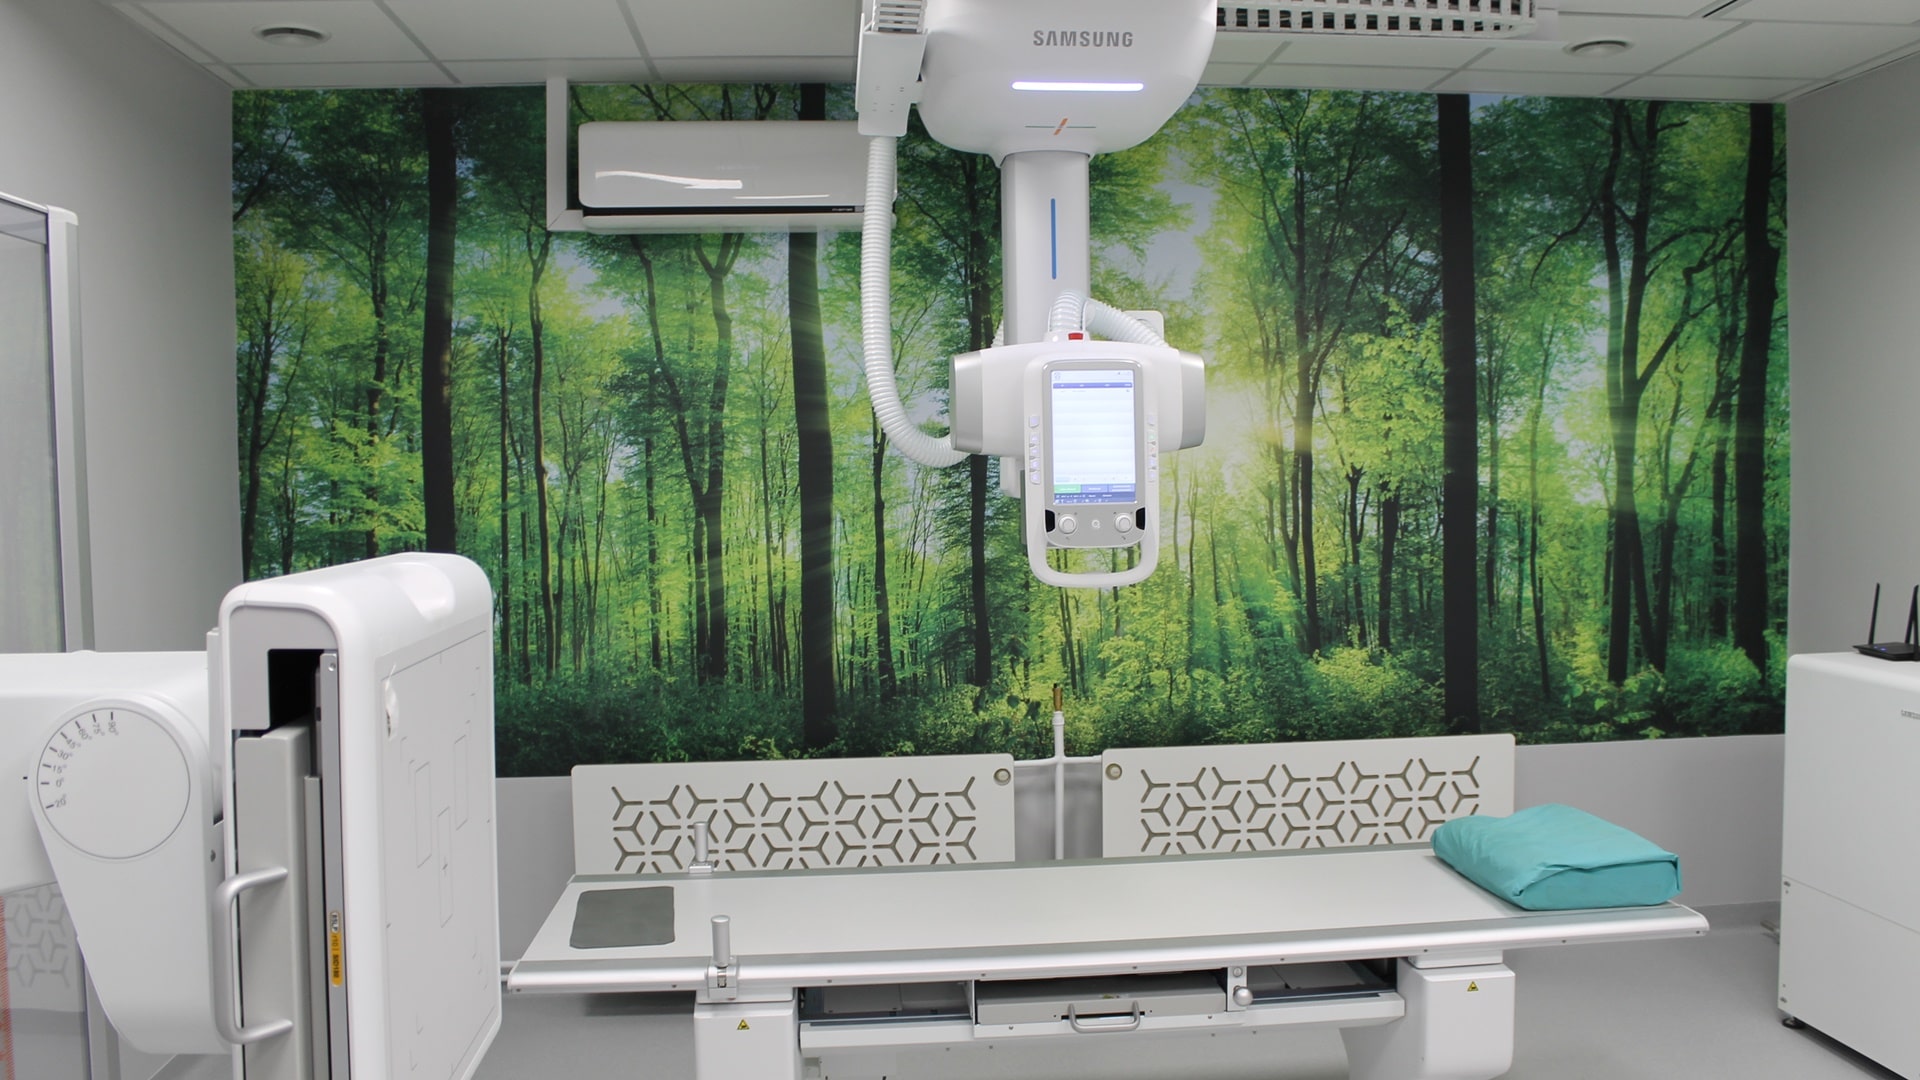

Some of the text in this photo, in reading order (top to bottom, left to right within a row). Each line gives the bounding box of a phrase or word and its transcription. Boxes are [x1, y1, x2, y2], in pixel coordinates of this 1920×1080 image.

[1033, 30, 1133, 47] SAMSUNG
[78, 728, 92, 740] 60°
[92, 723, 105, 736] 75°
[108, 721, 119, 736] 90°
[66, 739, 81, 749] 45°
[57, 750, 73, 761] 30°
[53, 764, 67, 774] 15°
